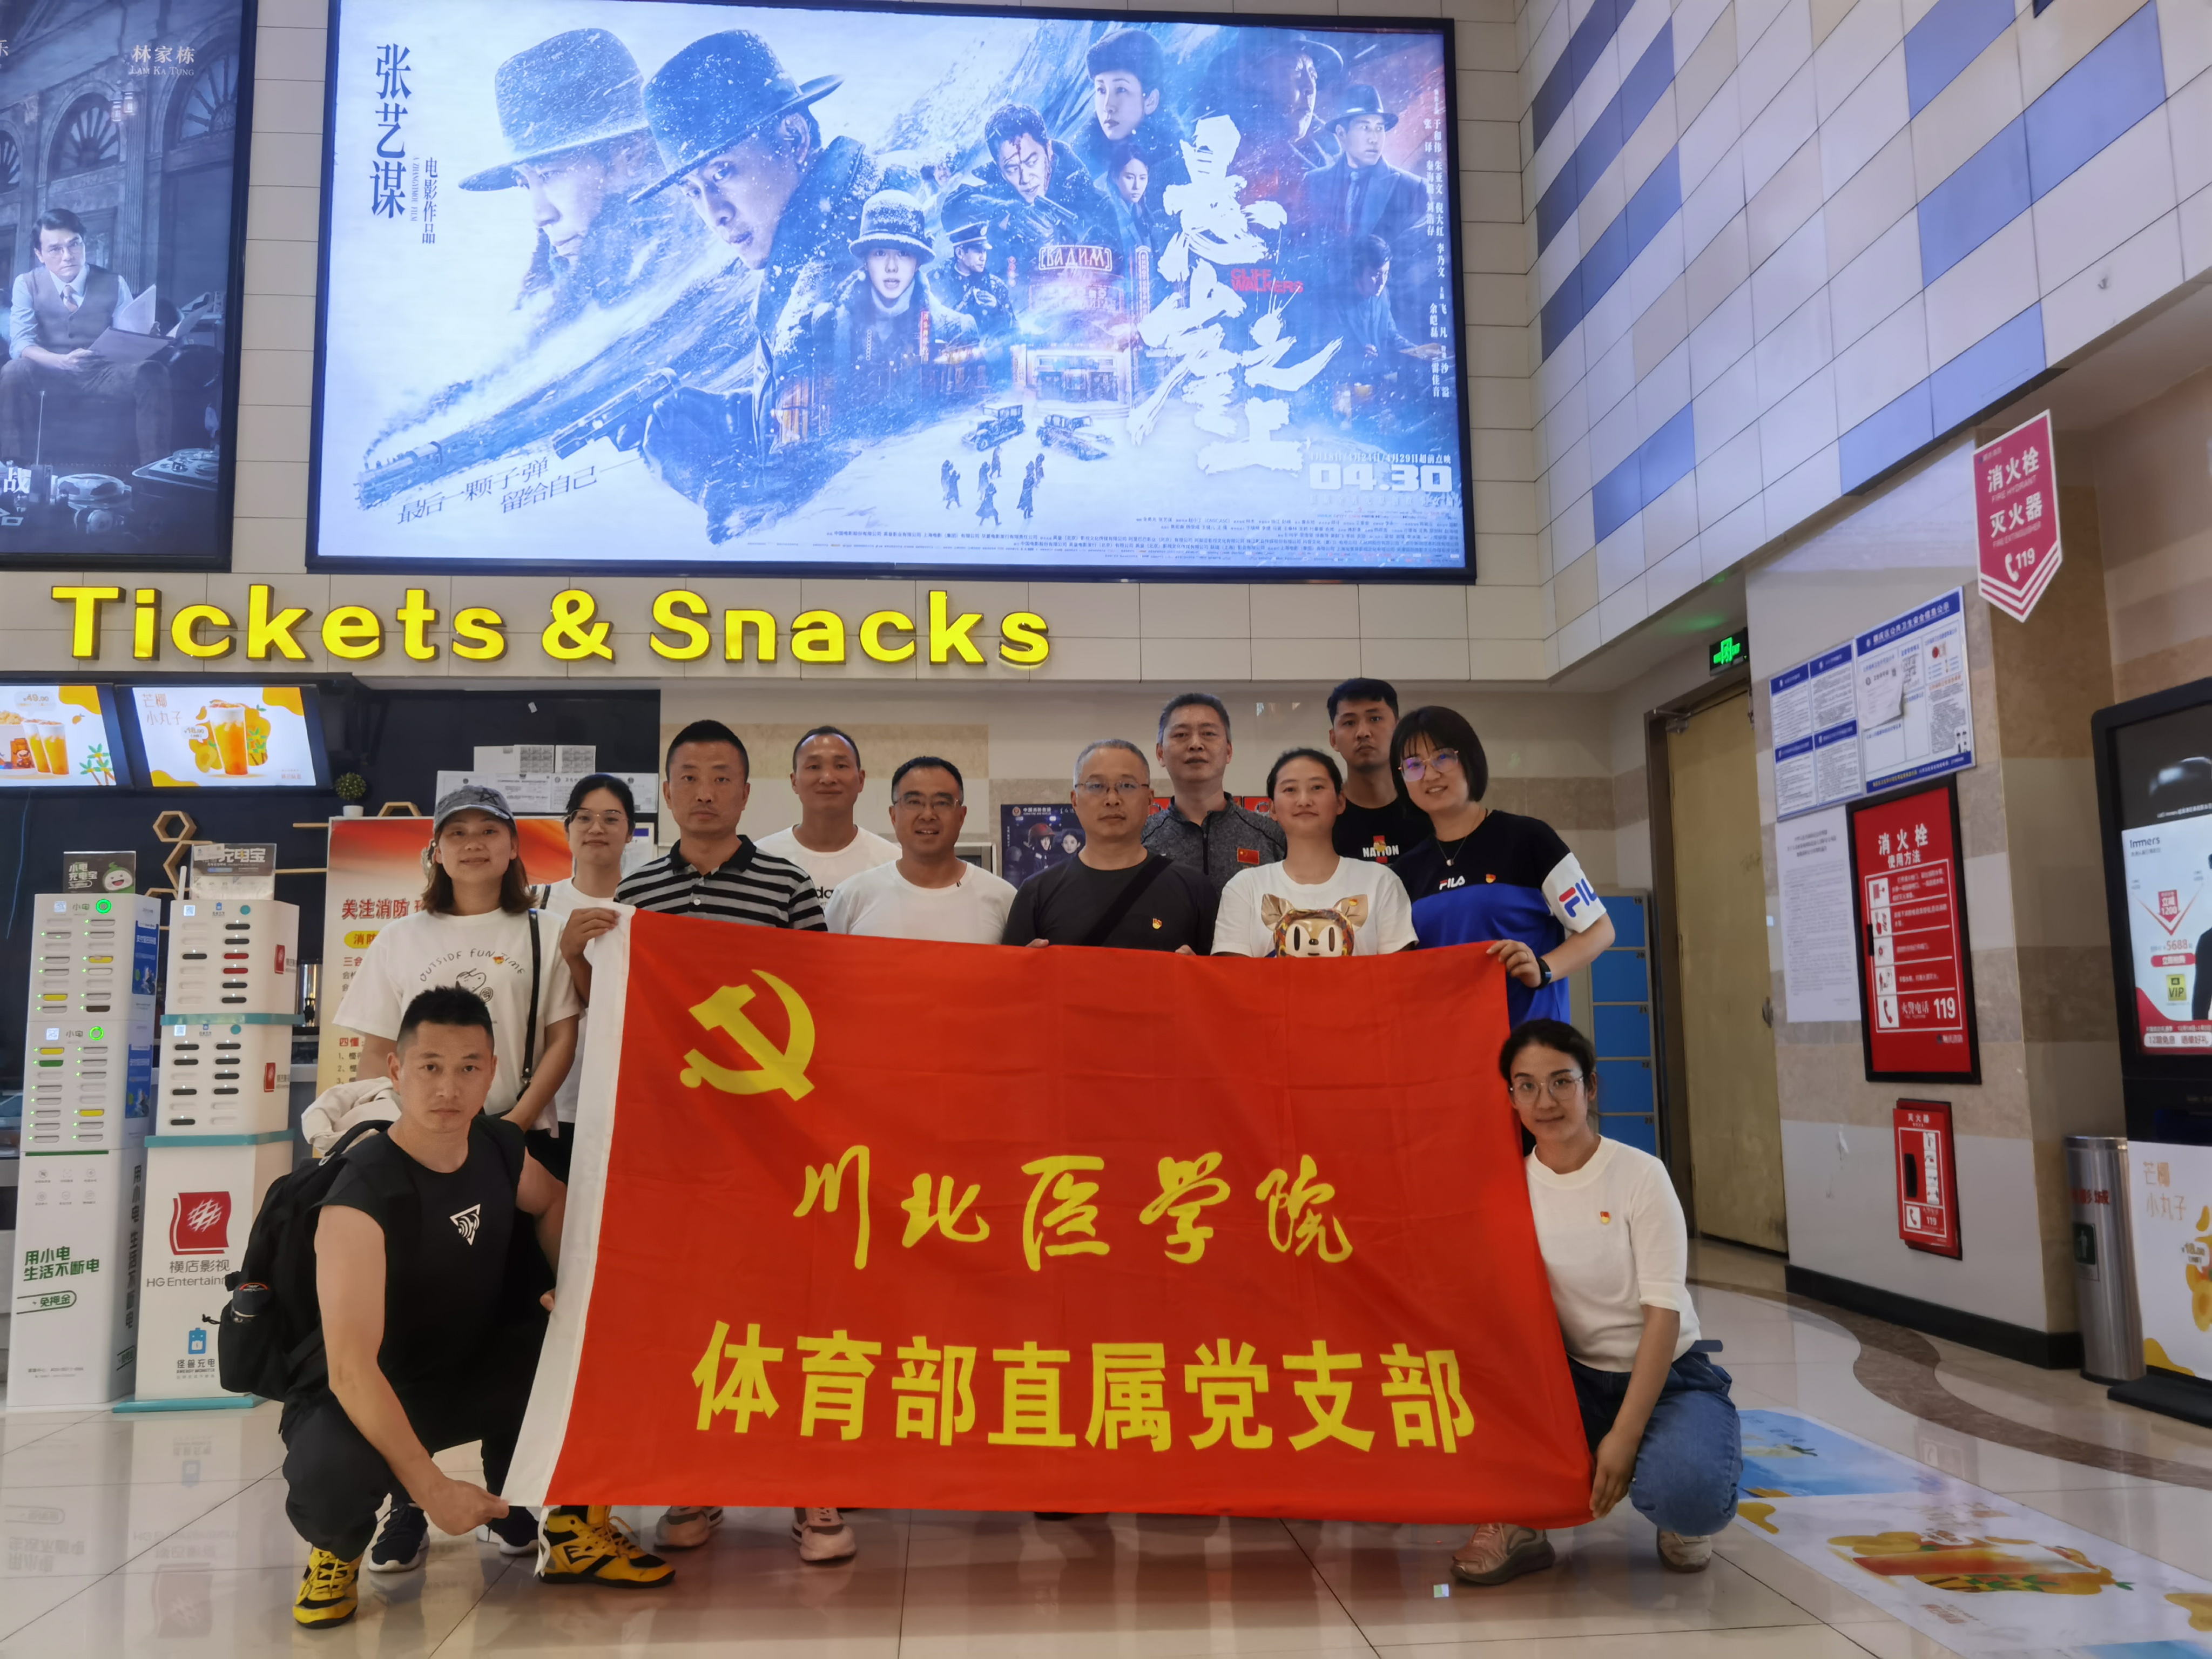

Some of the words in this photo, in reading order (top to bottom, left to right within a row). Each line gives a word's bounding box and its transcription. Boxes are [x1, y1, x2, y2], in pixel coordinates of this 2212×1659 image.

[132, 45, 195, 64] 林家栋
[369, 43, 412, 219] 张艺谋
[422, 157, 438, 244] 电影作品
[1231, 268, 1271, 279] CLIFF
[1231, 279, 1303, 293] WALKERS
[1309, 463, 1453, 492] 04.30
[1987, 446, 2039, 493] 消火栓
[398, 457, 549, 525] 最后一颗子弹
[502, 465, 597, 514] 留给自己
[1992, 490, 2006, 503] FIRE
[1990, 491, 2042, 538] 灭火器
[2015, 547, 2035, 569] 119
[51, 583, 510, 663] Tickets
[541, 588, 616, 664] &
[650, 588, 1050, 666] Snacks
[147, 711, 183, 725] 小丸子
[1878, 824, 1928, 856] 消火栓
[69, 863, 88, 872] 小电
[1887, 849, 1921, 868] 使用方法
[69, 871, 98, 881] 充电宝
[1439, 875, 1465, 890] FILA
[341, 898, 409, 920] 关注消防
[470, 948, 495, 957] FUN
[2167, 939, 2188, 951] 5688
[2169, 987, 2184, 998] VIP
[1933, 997, 1956, 1020] 119
[793, 1144, 1353, 1272] 川北医学院
[2147, 1192, 2187, 1221] 小丸子
[24, 1246, 71, 1266] 用小电
[169, 1259, 231, 1273] 横店影视
[23, 1258, 100, 1282] 生活不断电
[146, 1277, 165, 1287] HG
[40, 1294, 71, 1308] 免押金
[177, 1358, 215, 1368] 怪兽充电
[691, 1319, 1476, 1454] 体育部直属党支部
